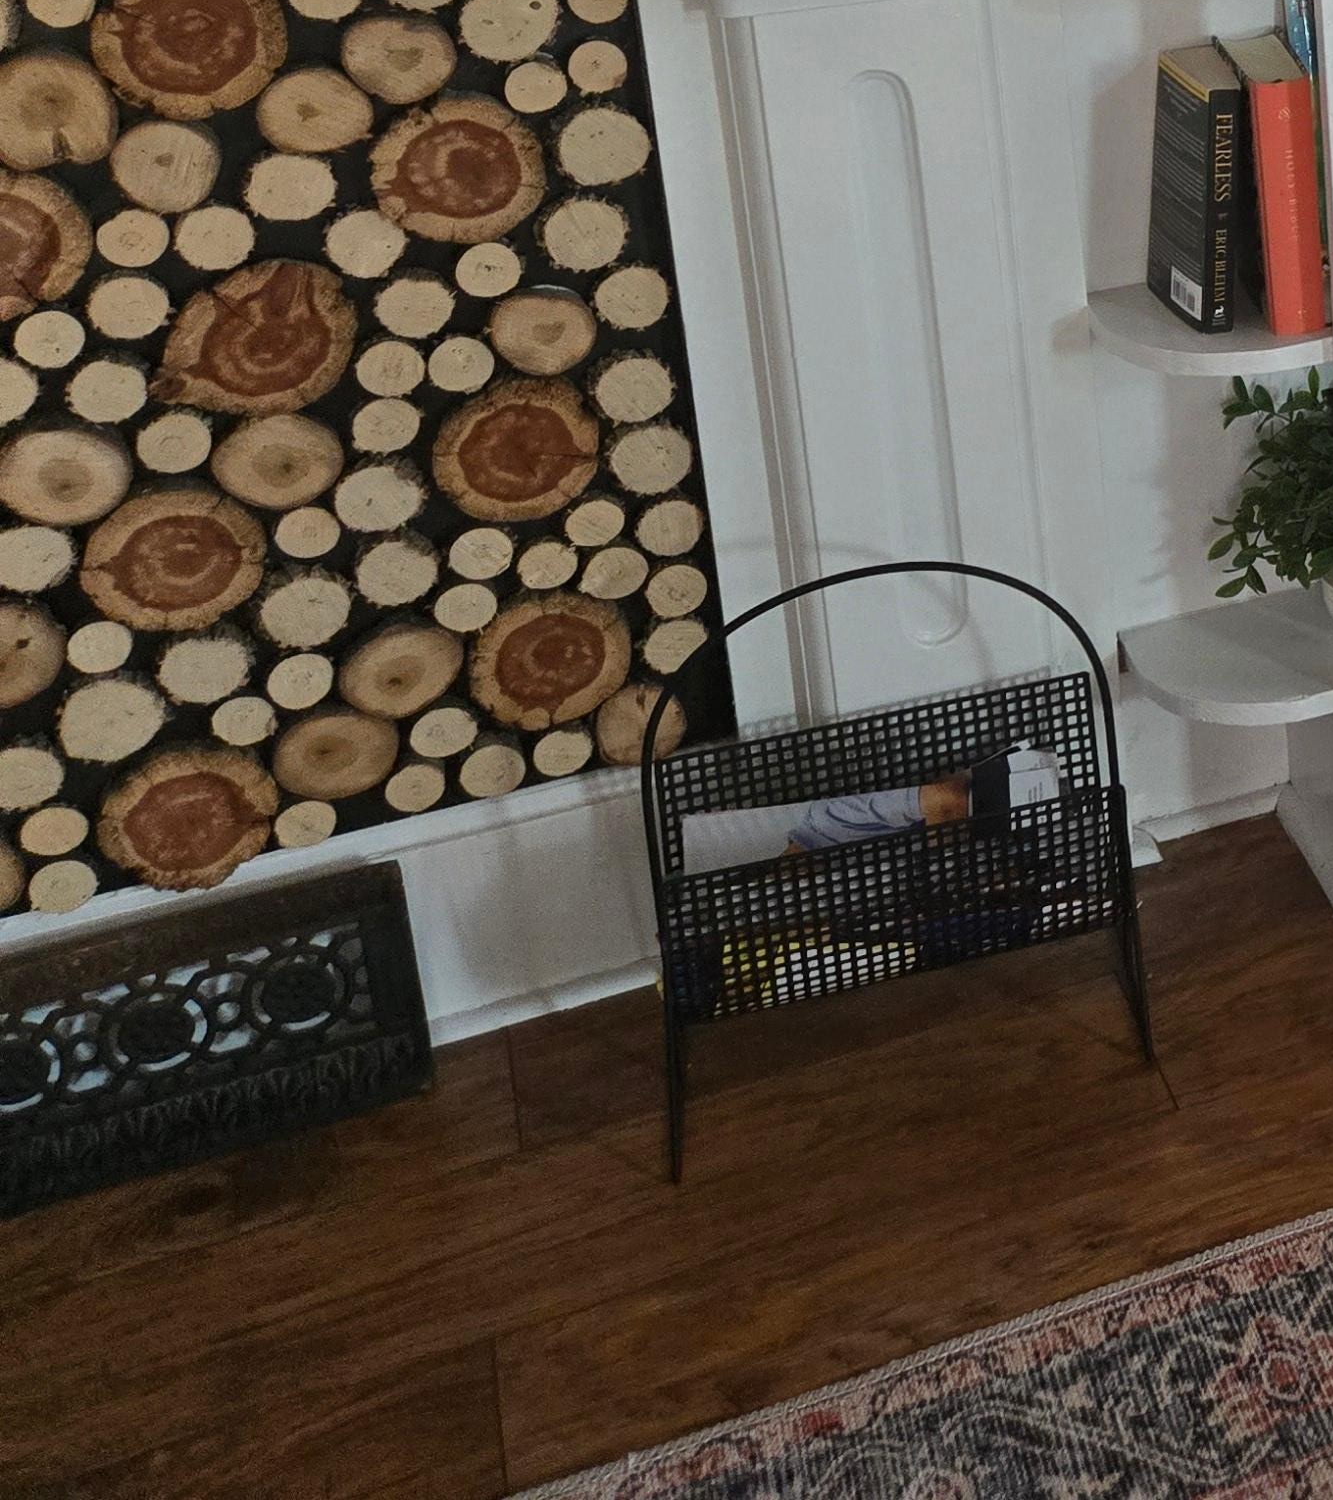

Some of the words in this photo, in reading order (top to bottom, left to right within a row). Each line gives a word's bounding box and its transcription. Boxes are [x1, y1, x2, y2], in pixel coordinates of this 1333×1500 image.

[1214, 114, 1232, 202] FEARLESS
[1284, 149, 1296, 190] HOLY
[1214, 229, 1227, 259] ERIC
[1214, 261, 1227, 302] BLEHM
